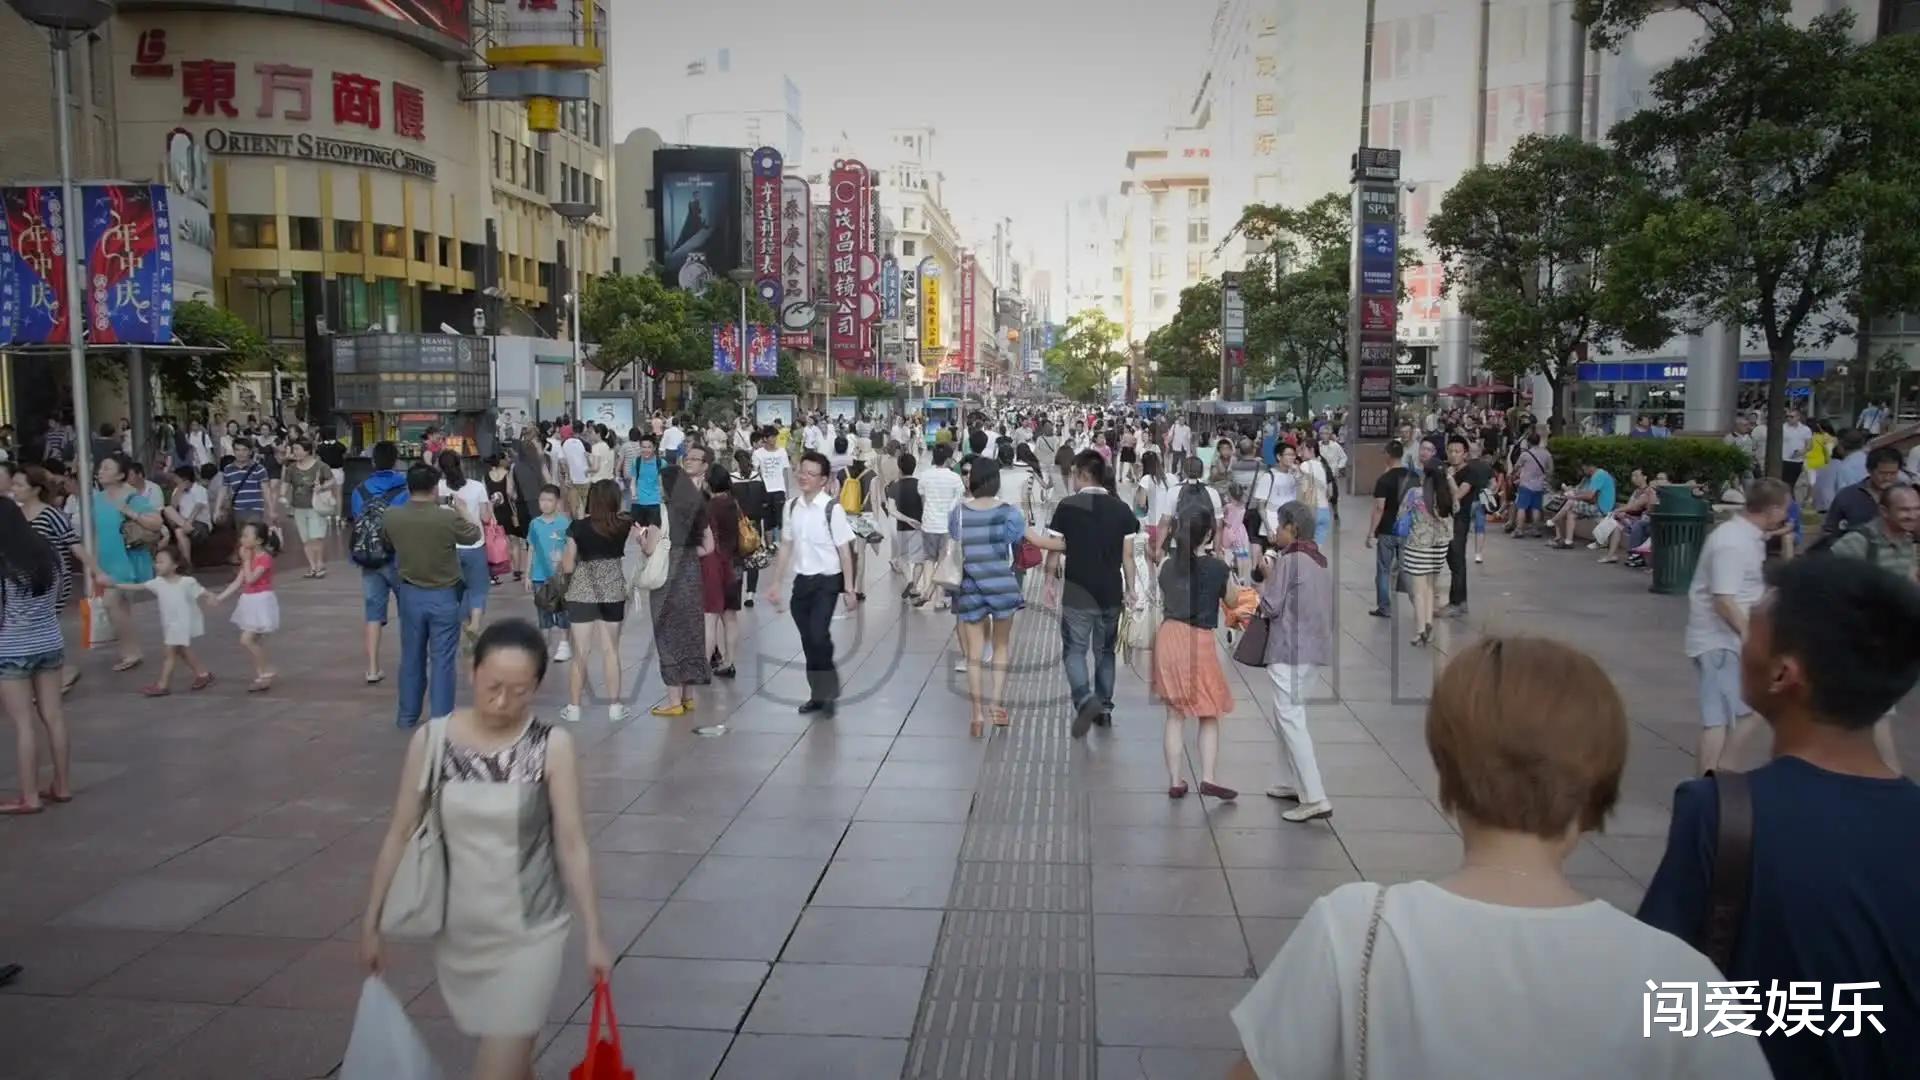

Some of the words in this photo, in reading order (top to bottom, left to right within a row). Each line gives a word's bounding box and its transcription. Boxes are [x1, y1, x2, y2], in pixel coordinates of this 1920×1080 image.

[205, 128, 294, 156] ORIENT
[297, 132, 391, 166] SHOPPING
[1367, 203, 1389, 215] SPA
[783, 195, 804, 298] 泰康食品
[834, 207, 857, 336] 茂昌眼镜公司
[421, 337, 453, 345] TRAVEL
